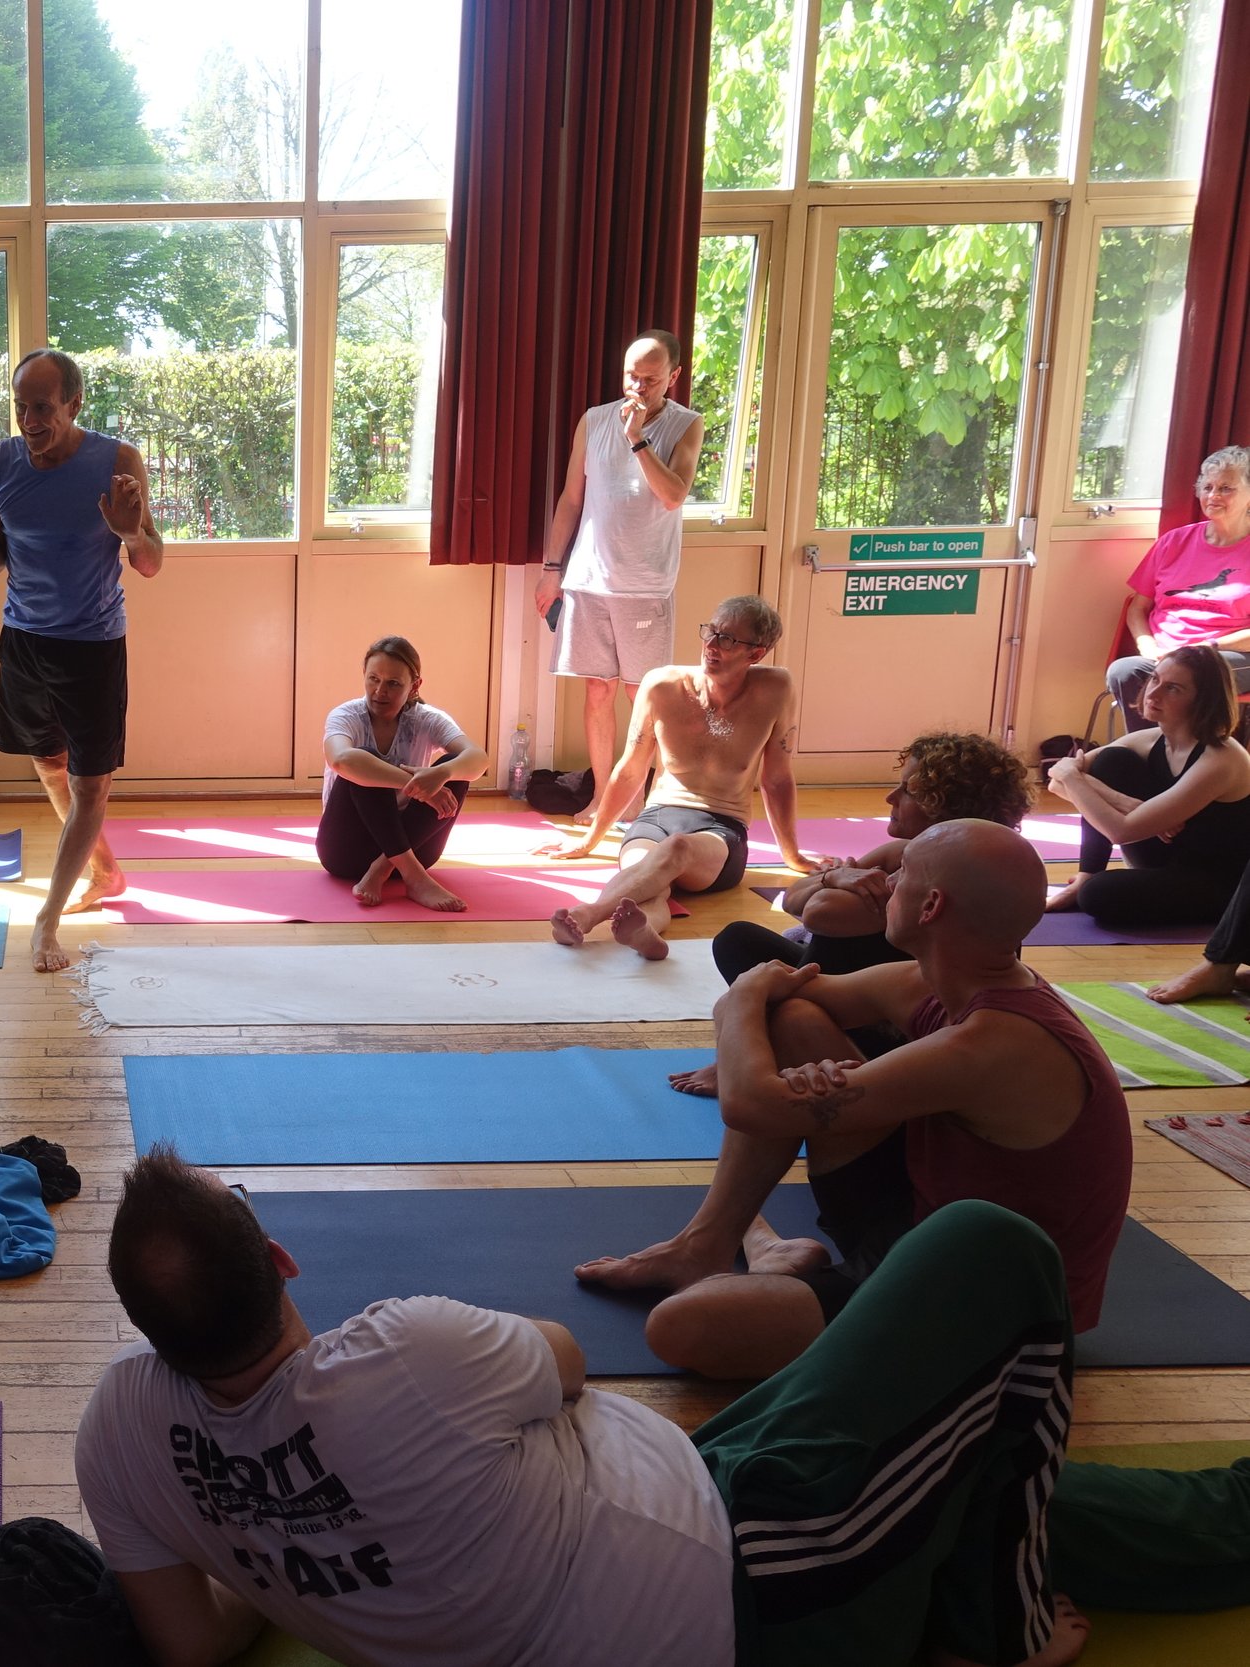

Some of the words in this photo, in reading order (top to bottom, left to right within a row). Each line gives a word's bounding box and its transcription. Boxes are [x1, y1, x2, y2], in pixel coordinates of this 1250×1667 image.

[874, 541, 905, 553] Push
[908, 540, 930, 552] bar
[933, 541, 946, 552] to
[948, 541, 979, 553] open
[846, 574, 969, 592] EMERGENCY
[844, 595, 888, 611] EXIT
